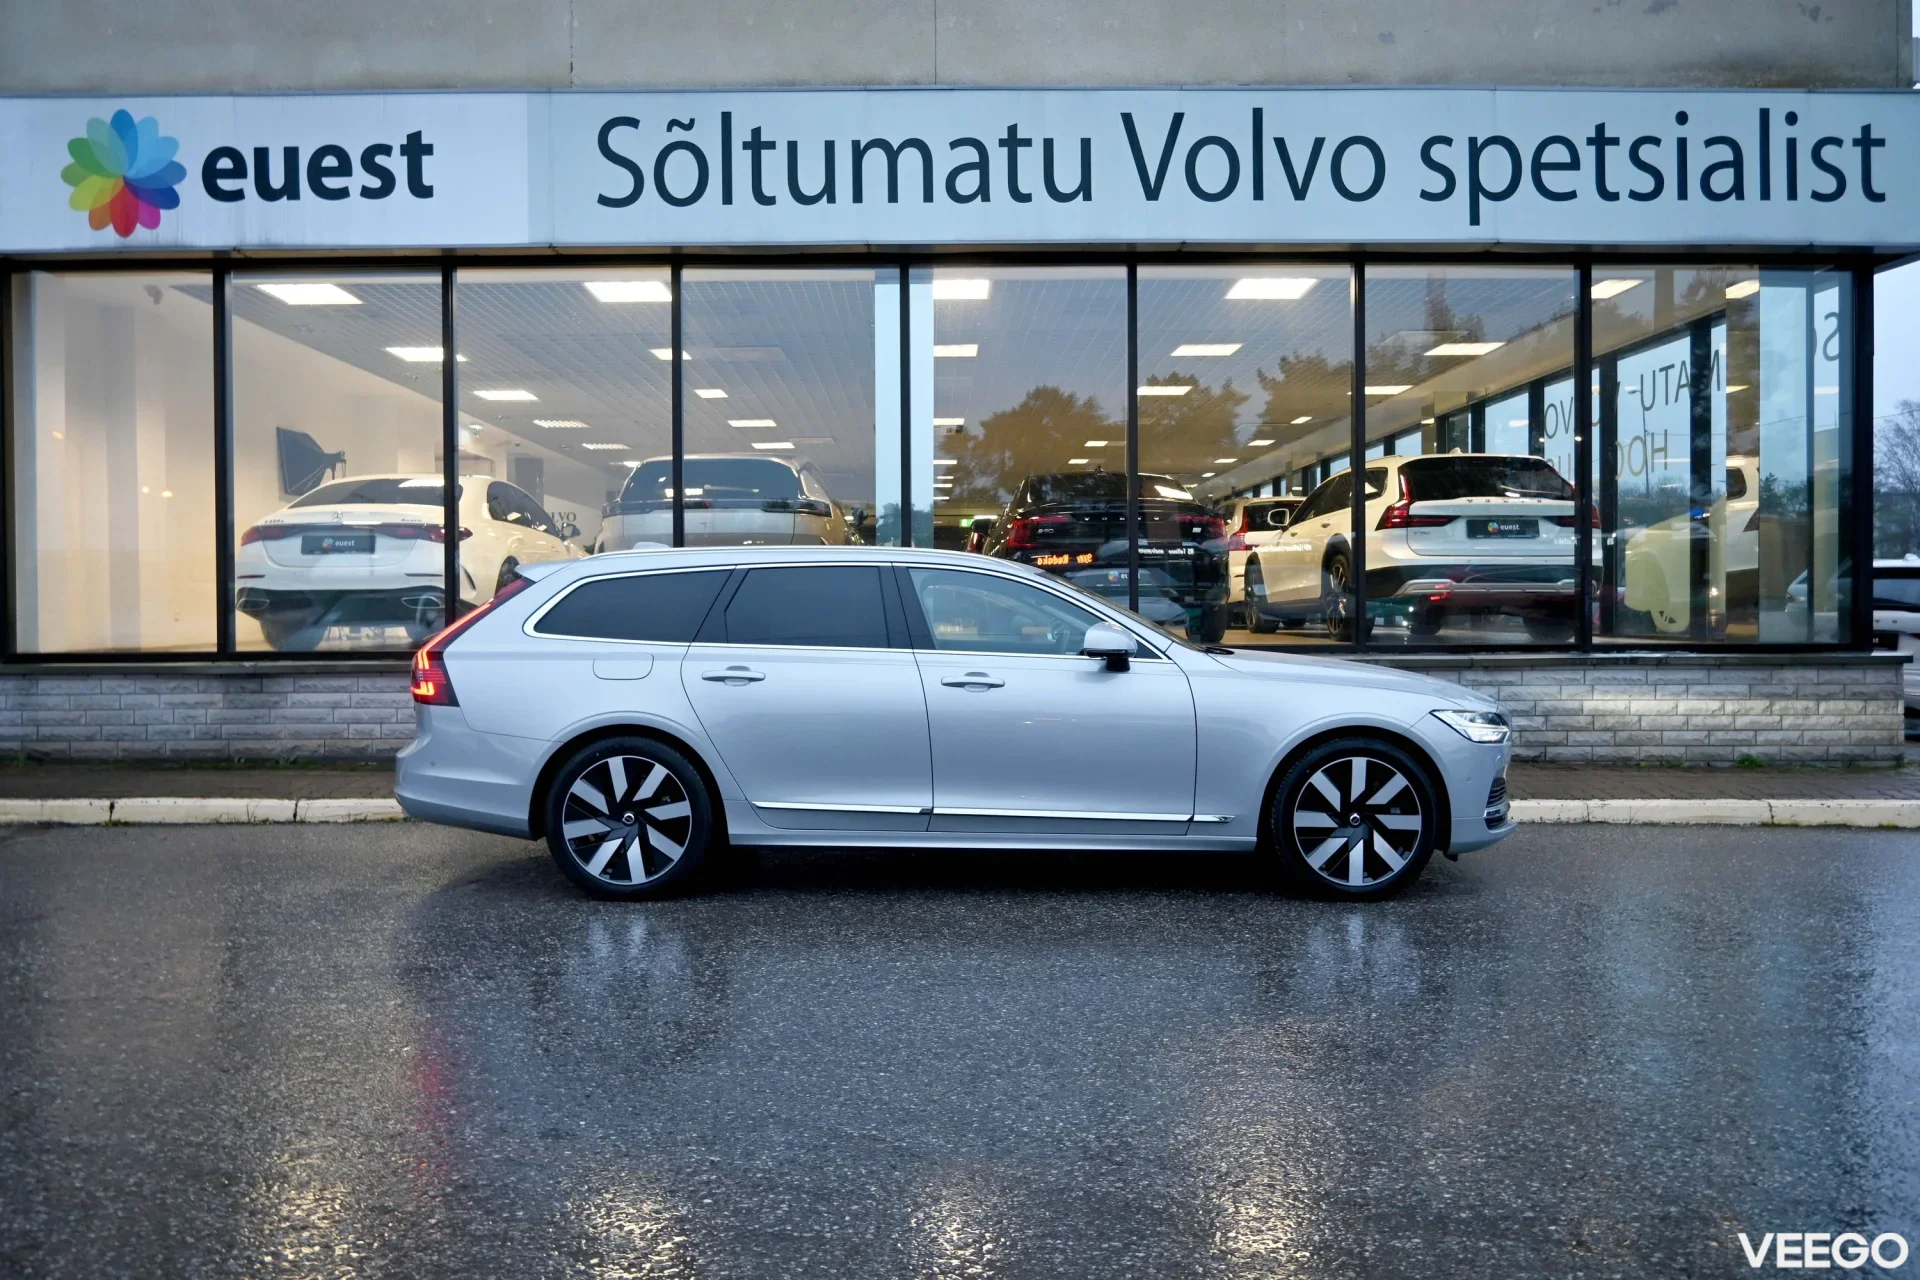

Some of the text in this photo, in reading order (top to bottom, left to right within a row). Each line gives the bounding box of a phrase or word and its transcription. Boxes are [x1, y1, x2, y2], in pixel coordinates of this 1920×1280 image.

[201, 130, 434, 202] euest
[597, 107, 1886, 226] Sõltumatu Volvo spetsialist
